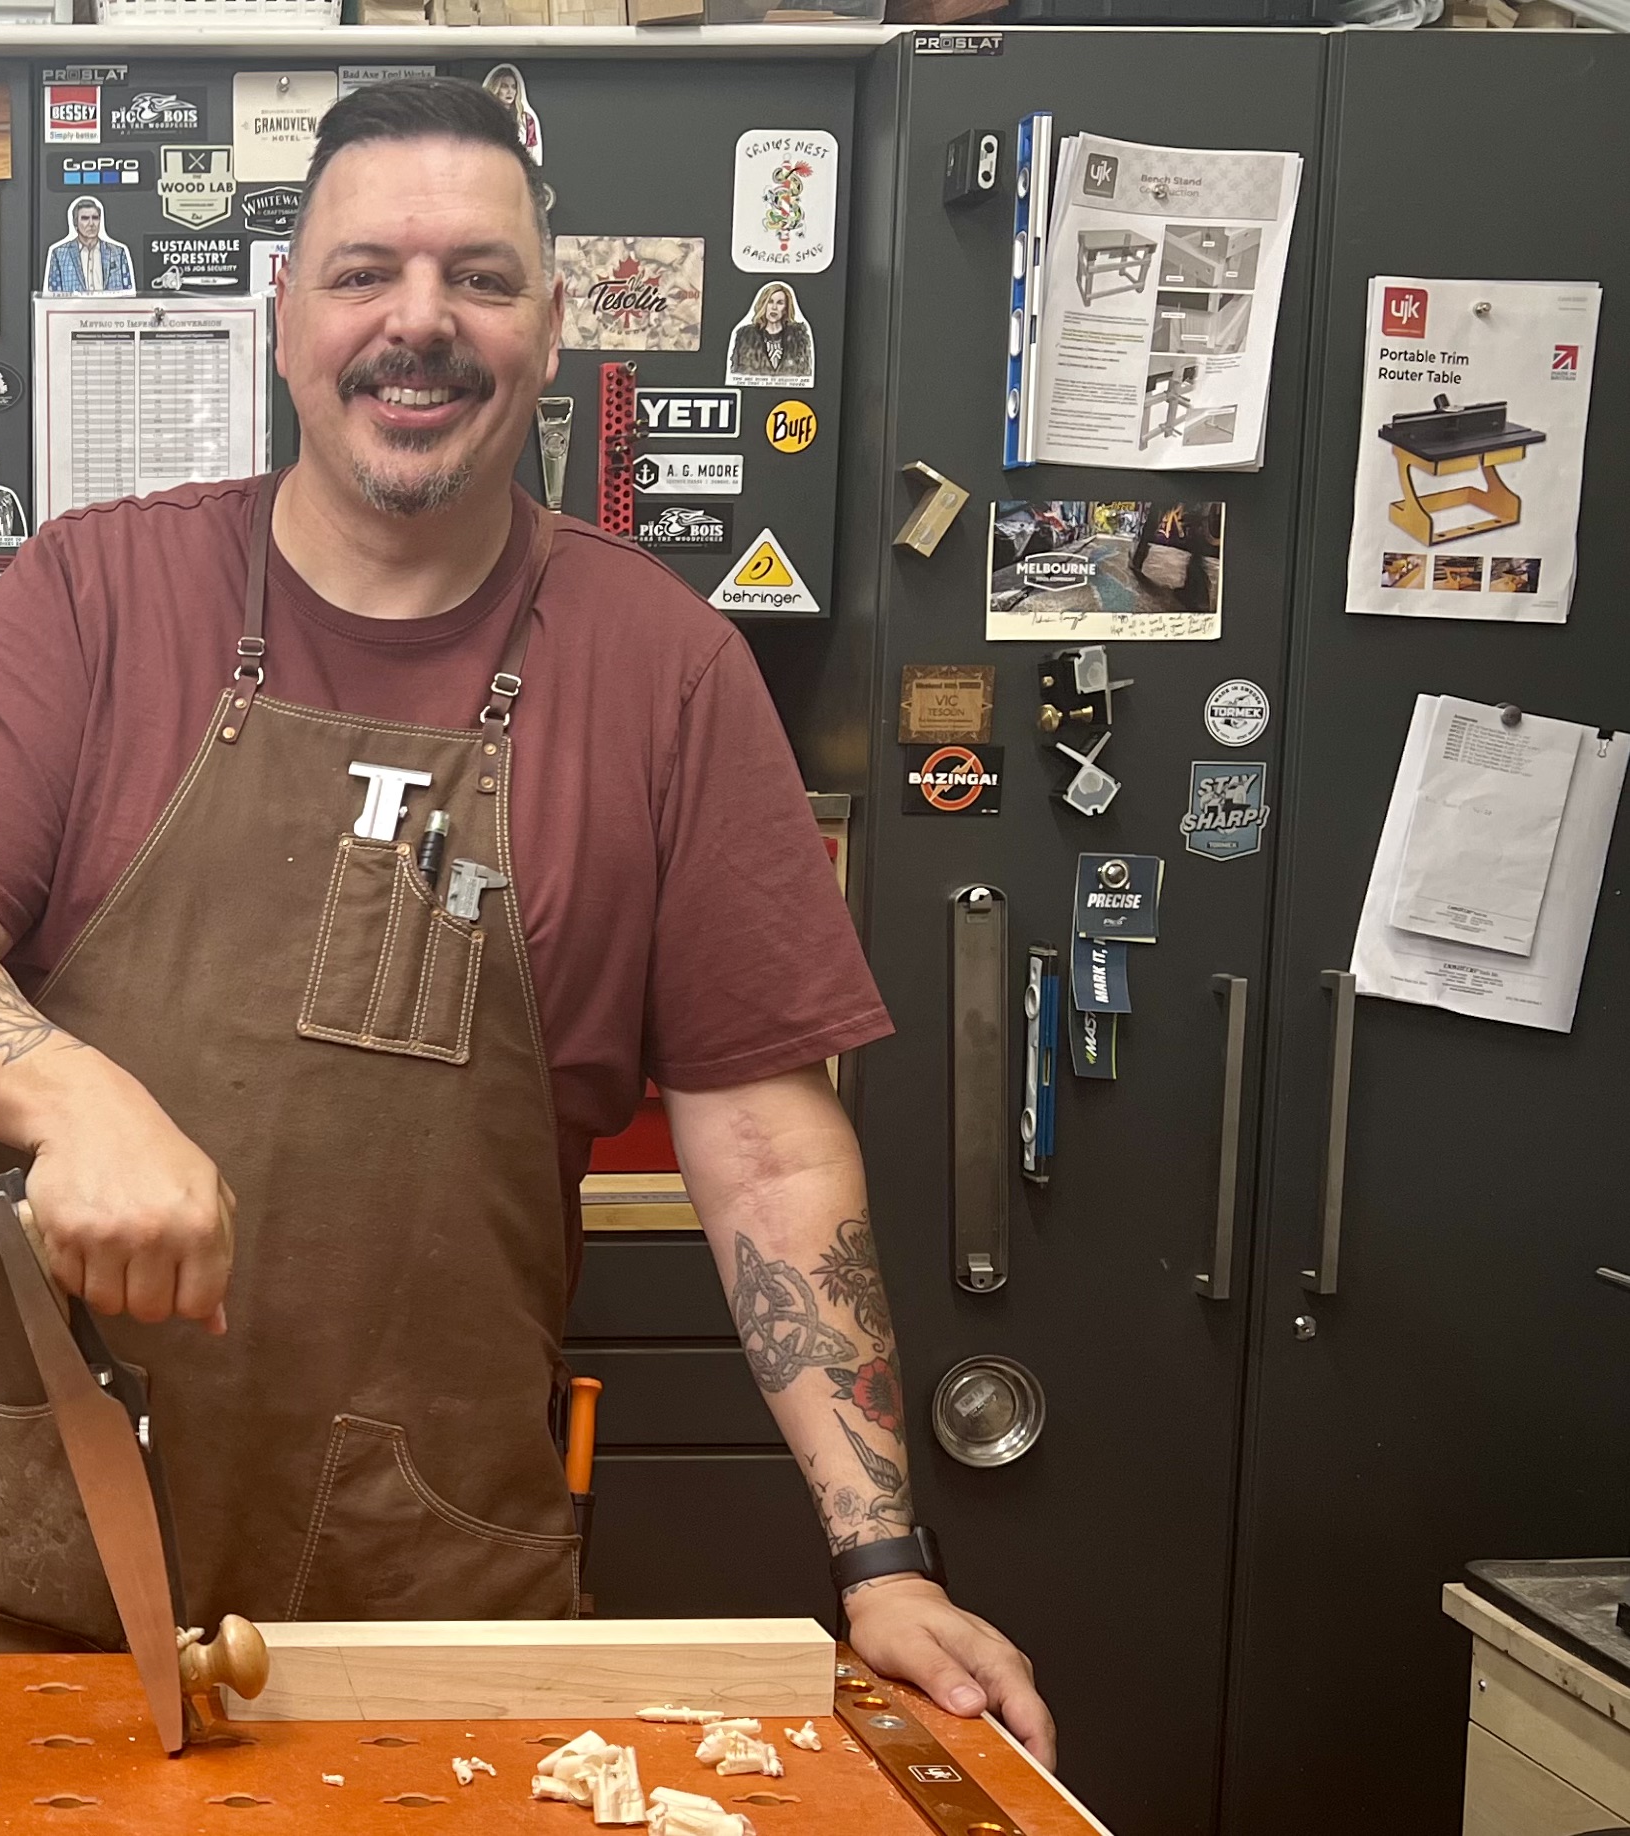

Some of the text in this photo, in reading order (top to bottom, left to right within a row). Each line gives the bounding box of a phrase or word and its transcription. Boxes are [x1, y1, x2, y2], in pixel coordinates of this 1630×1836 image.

[915, 37, 1003, 49] PROSLAT
[42, 68, 128, 81] PROSLAT
[343, 70, 360, 79] Bad
[362, 70, 379, 79] Axe
[51, 104, 96, 121] BESSEY
[164, 110, 198, 122] BOIS
[254, 116, 317, 134] GRANDVIEW
[50, 130, 74, 140] Simply
[794, 141, 830, 159] NEST
[63, 157, 139, 171] GoPro
[1090, 160, 1112, 188] ujk
[1140, 174, 1202, 186] Bench Stand
[161, 182, 234, 193] WOOD LAB
[241, 194, 300, 216] WHITEWA
[151, 240, 240, 252] SUSTAINABLE
[163, 252, 228, 264] FORESTRY
[206, 264, 237, 272] SECURITY
[587, 280, 668, 315] Tesolin
[1390, 294, 1420, 325] ujk
[114, 320, 125, 328] TO
[1379, 348, 1470, 366] Portable Trim
[1378, 367, 1462, 385] Router Table
[640, 399, 730, 428] YETI
[772, 411, 813, 444] Buff
[667, 464, 739, 477] A. G. MOORE
[690, 524, 724, 536] BOIS
[1016, 562, 1096, 575] MELBOURNE
[723, 590, 802, 607] behringer
[934, 694, 959, 707] VIC
[1212, 706, 1262, 718] TORMEK
[908, 772, 998, 786] BAZINGA!
[1197, 773, 1258, 797] STAY
[1182, 808, 1266, 832] SHARP!
[1087, 893, 1142, 909] PRECISE
[1091, 949, 1110, 1004] MARK IT,
